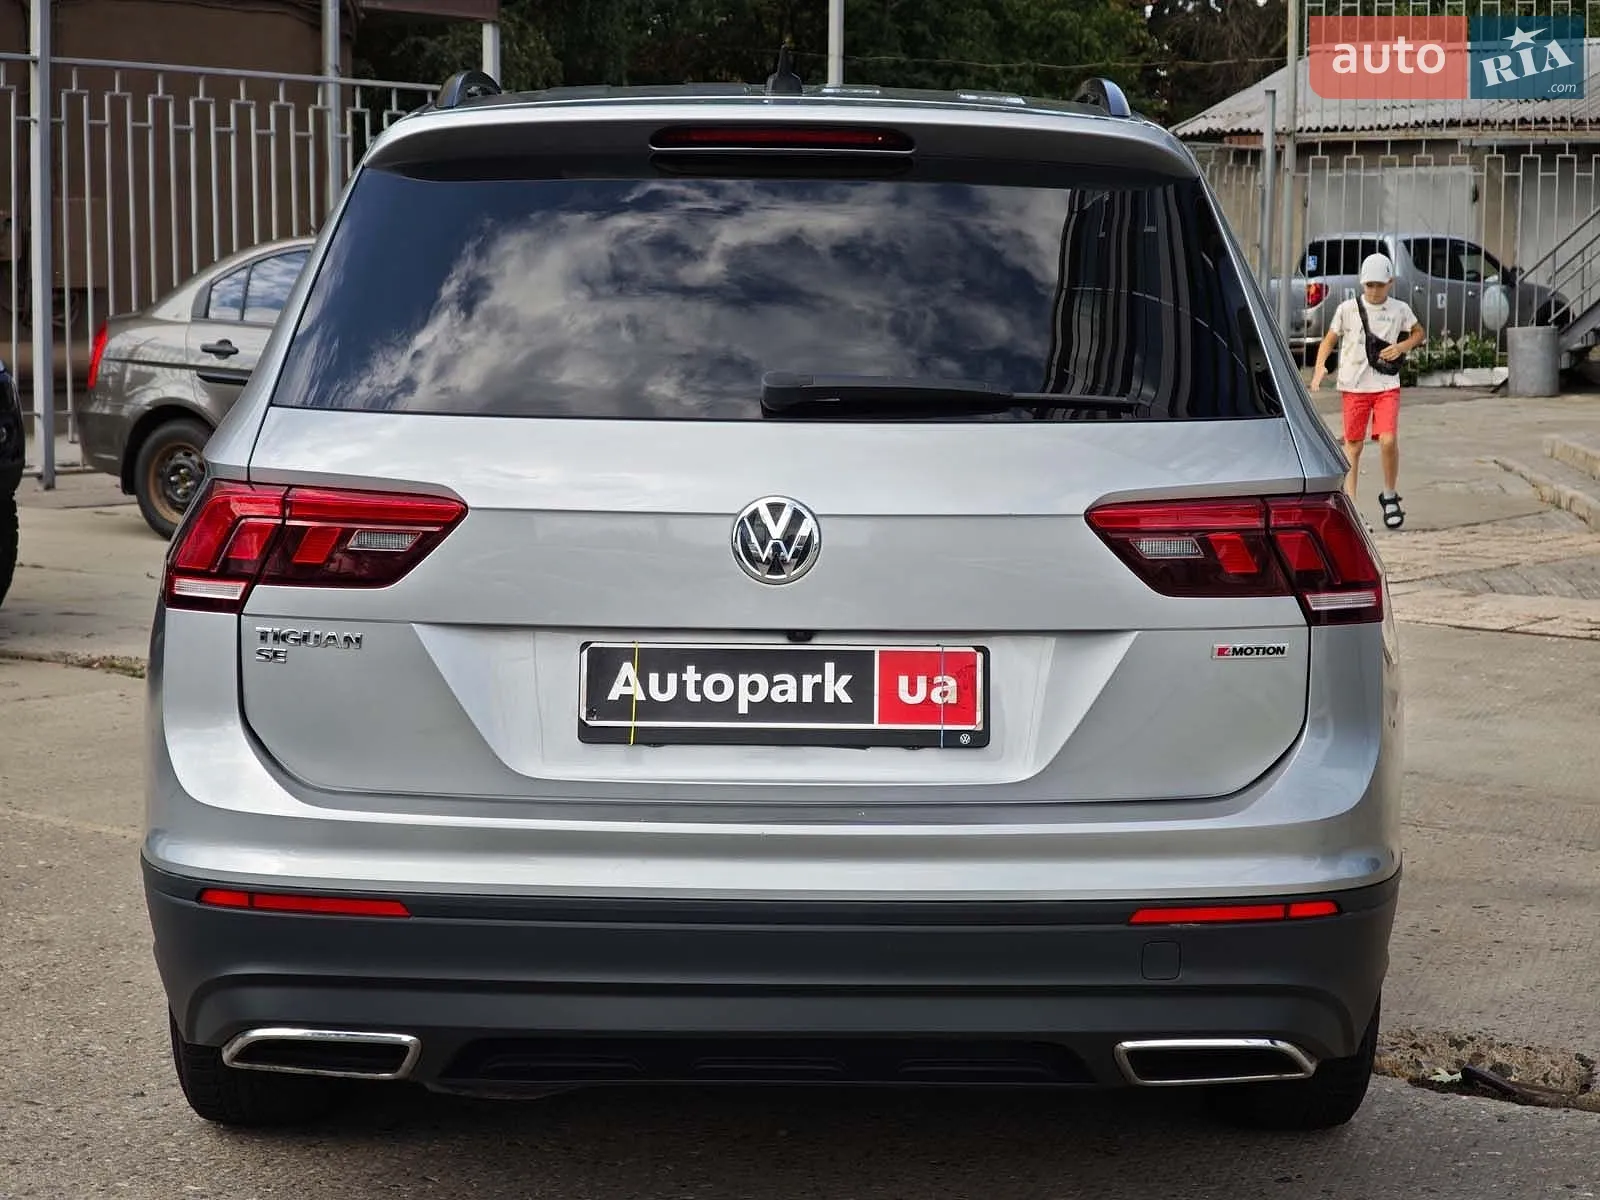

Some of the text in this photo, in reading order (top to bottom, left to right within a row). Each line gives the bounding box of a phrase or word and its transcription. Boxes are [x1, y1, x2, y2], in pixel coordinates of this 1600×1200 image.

[255, 626, 363, 648] TIGUAN
[255, 647, 288, 664] SE
[607, 662, 958, 714] Autopark ua
